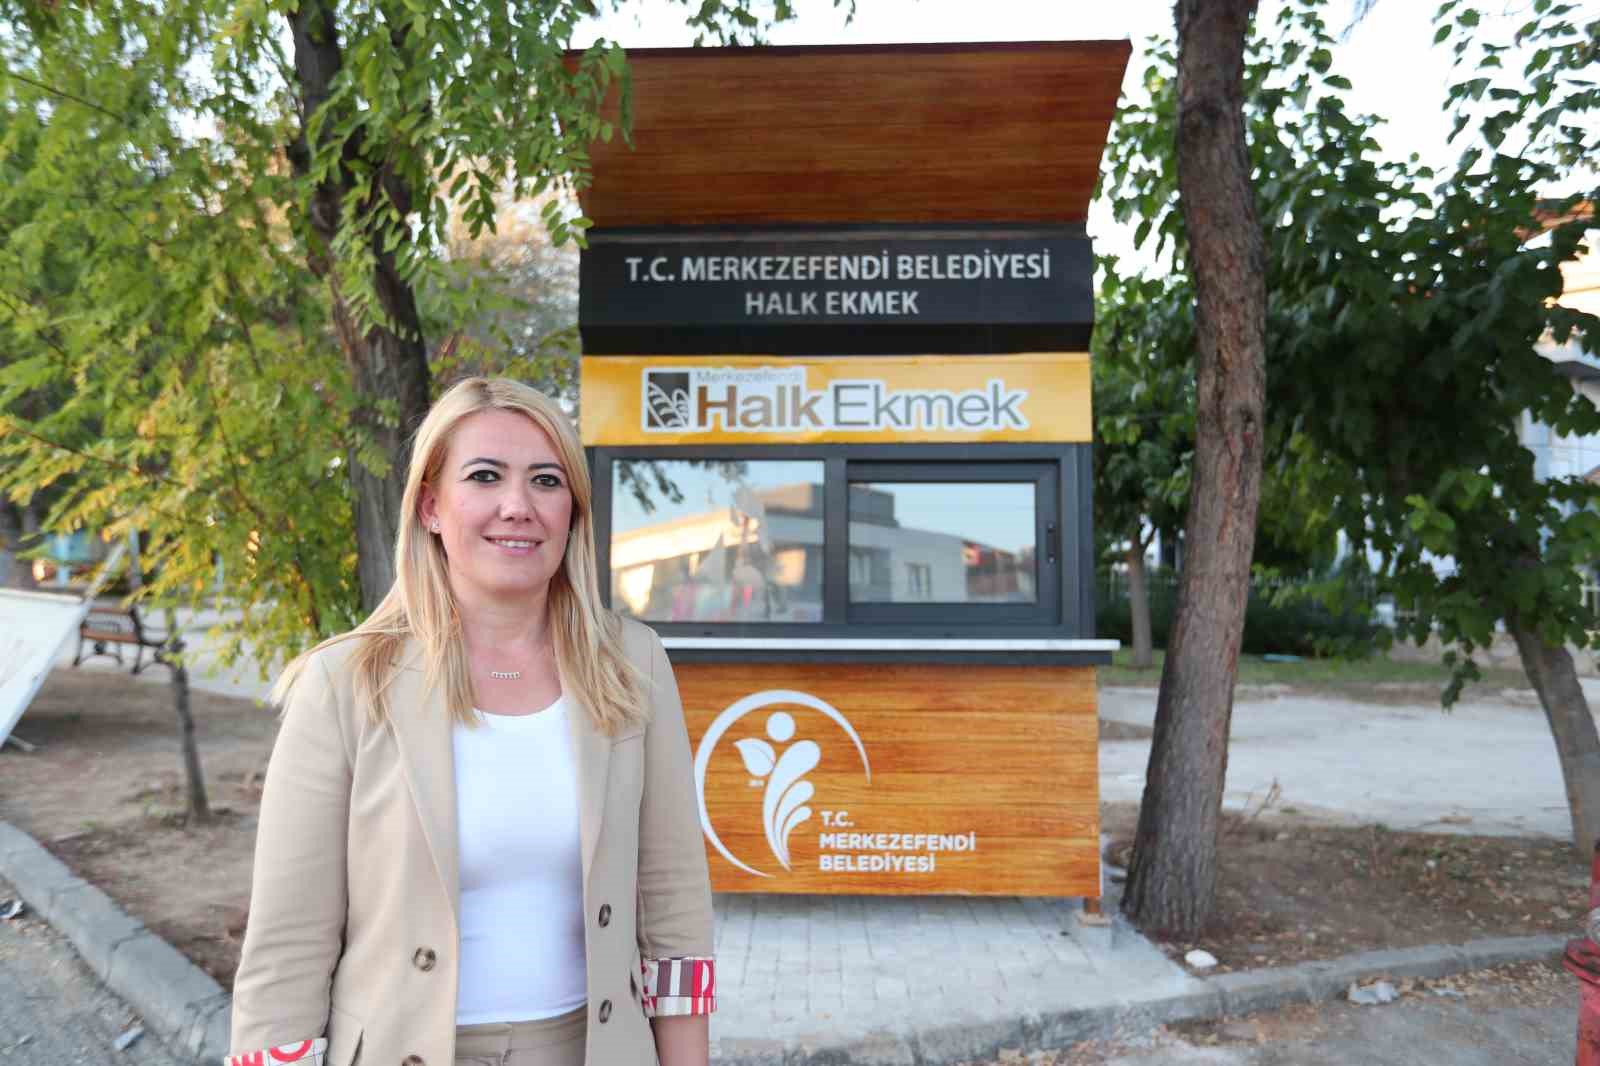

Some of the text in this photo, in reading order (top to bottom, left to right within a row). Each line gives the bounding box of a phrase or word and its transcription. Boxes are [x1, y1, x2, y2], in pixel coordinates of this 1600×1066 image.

[626, 249, 1050, 282] T.C. MERKEZEFENDİ BELEDİYESİ
[745, 291, 919, 316] HALK EKMEK
[697, 380, 1026, 428] Halk Ekmek
[820, 811, 854, 827] T.C.
[819, 832, 976, 852] MERKEZEFENDİ
[819, 853, 936, 873] BELEDİYESİ
